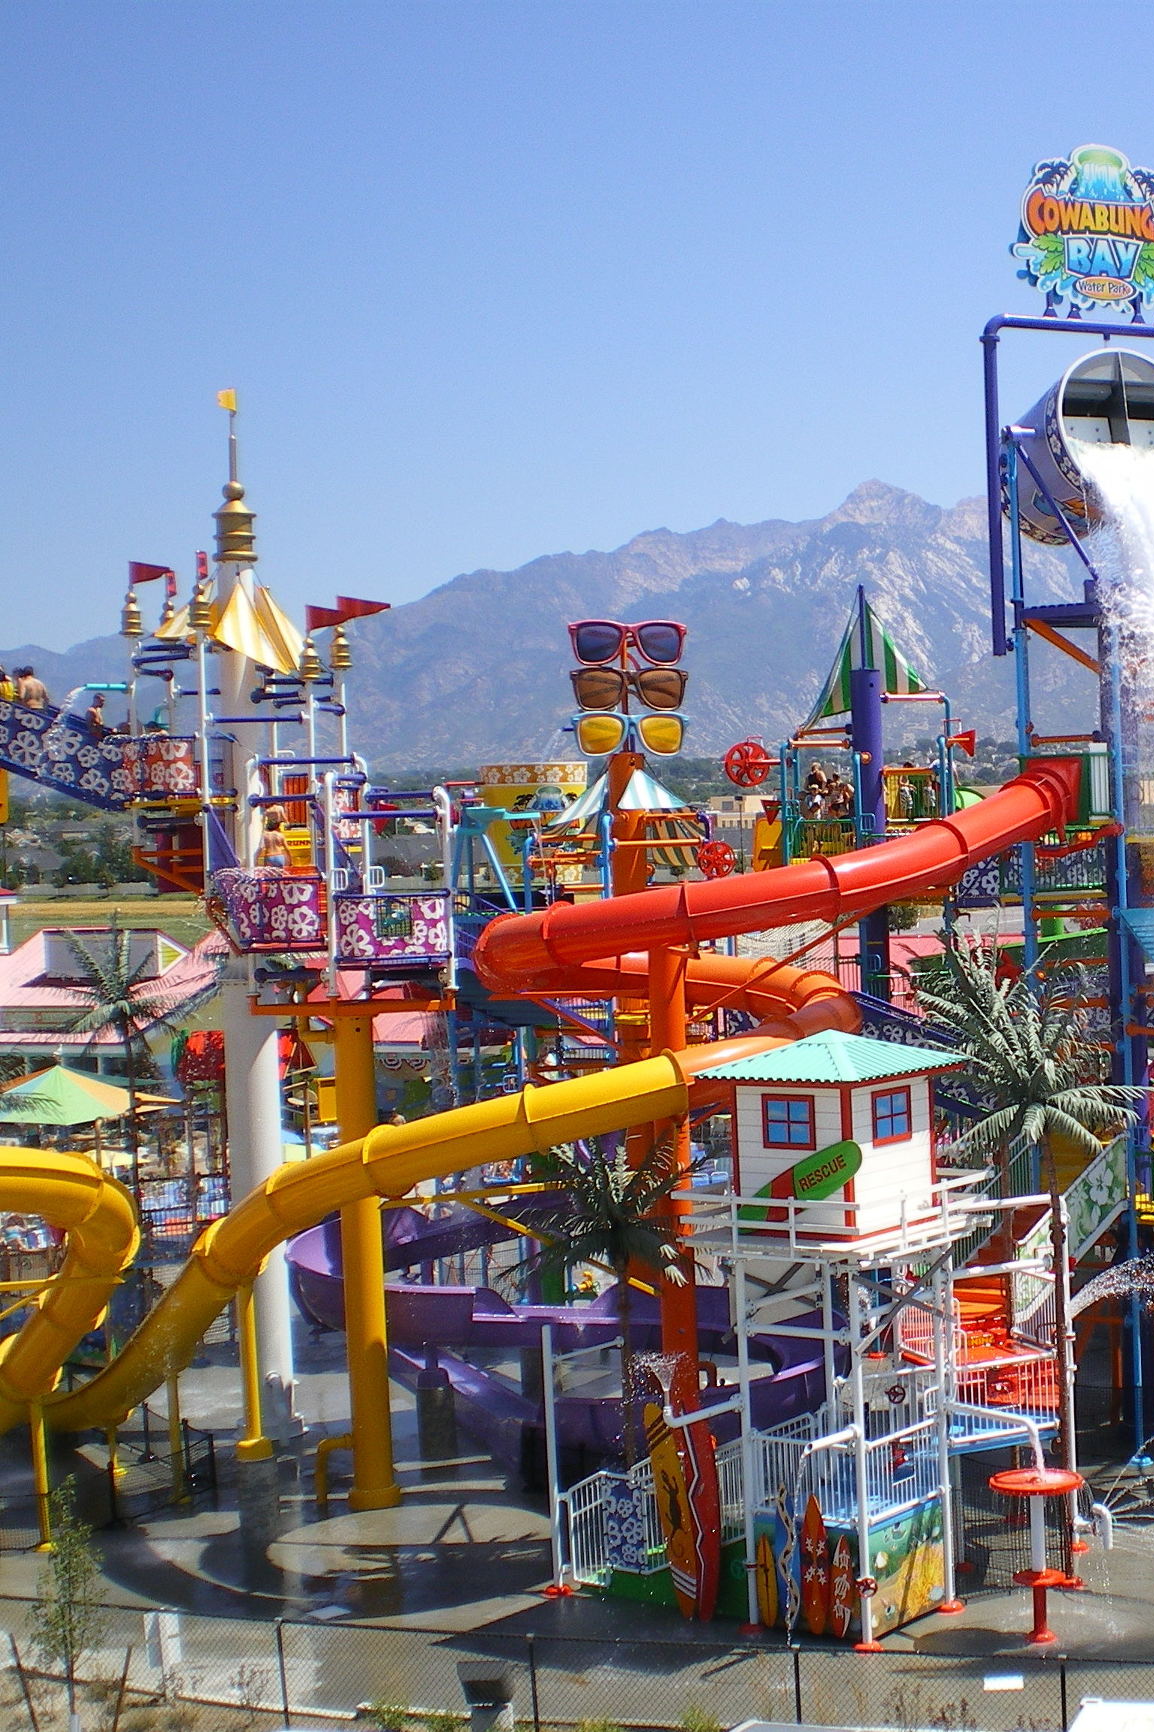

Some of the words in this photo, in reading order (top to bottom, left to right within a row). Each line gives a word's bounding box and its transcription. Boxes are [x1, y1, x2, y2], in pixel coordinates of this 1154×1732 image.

[1067, 236, 1137, 277] BAY
[1078, 280, 1105, 293] Water
[1108, 281, 1131, 296] Park
[798, 1154, 847, 1192] RESCUE
